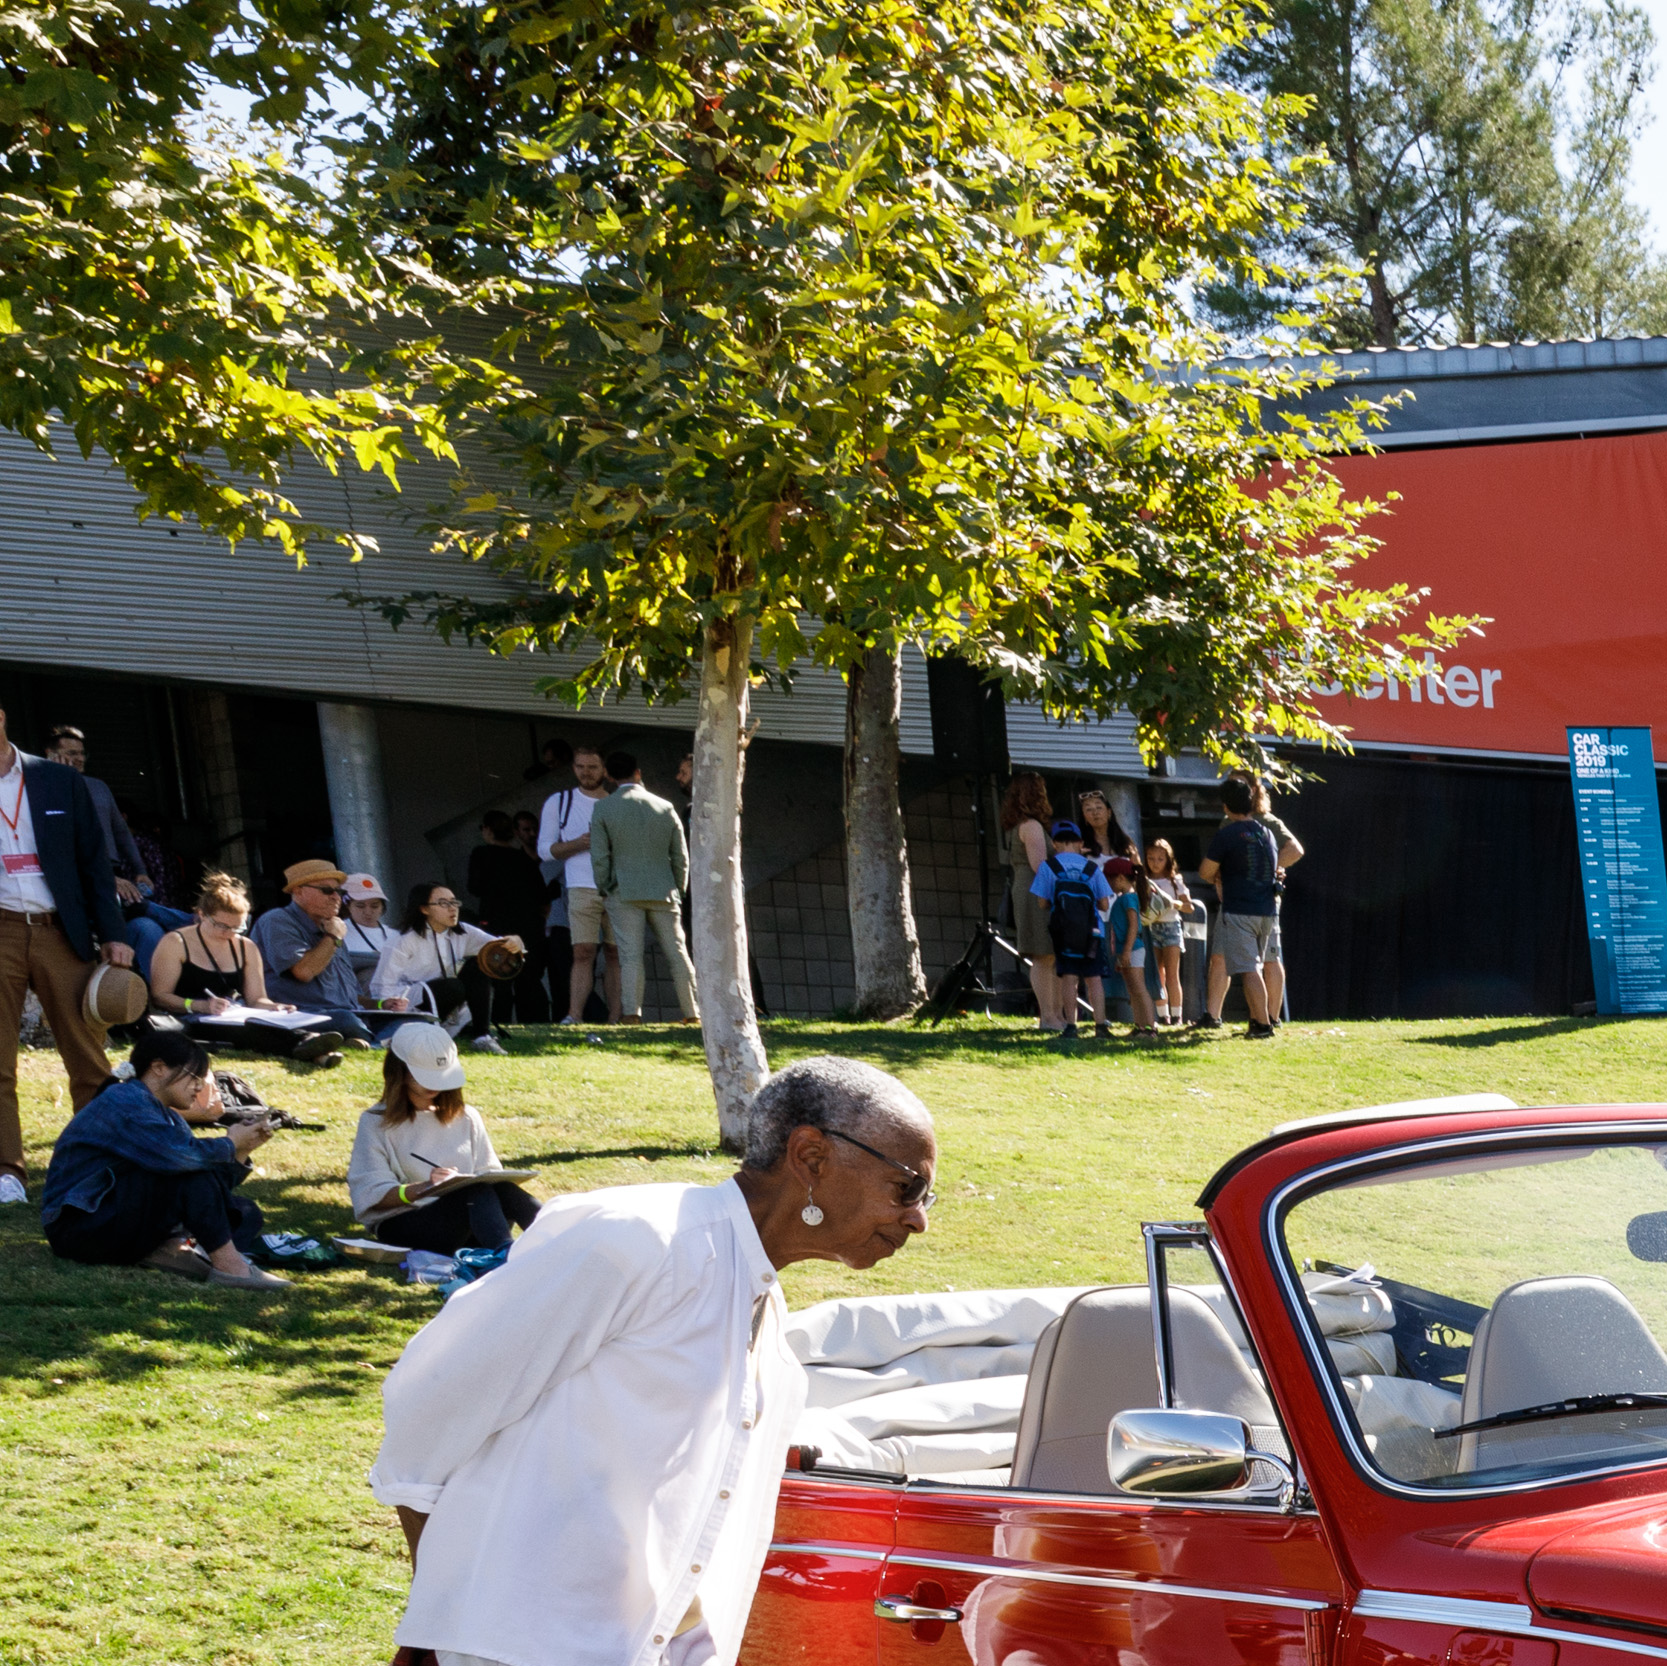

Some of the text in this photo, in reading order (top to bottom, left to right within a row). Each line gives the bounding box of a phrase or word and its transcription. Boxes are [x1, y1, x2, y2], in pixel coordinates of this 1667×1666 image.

[1572, 733, 1600, 745] CAR
[1573, 744, 1629, 756] CLASSIC
[1575, 755, 1606, 767] 2019
